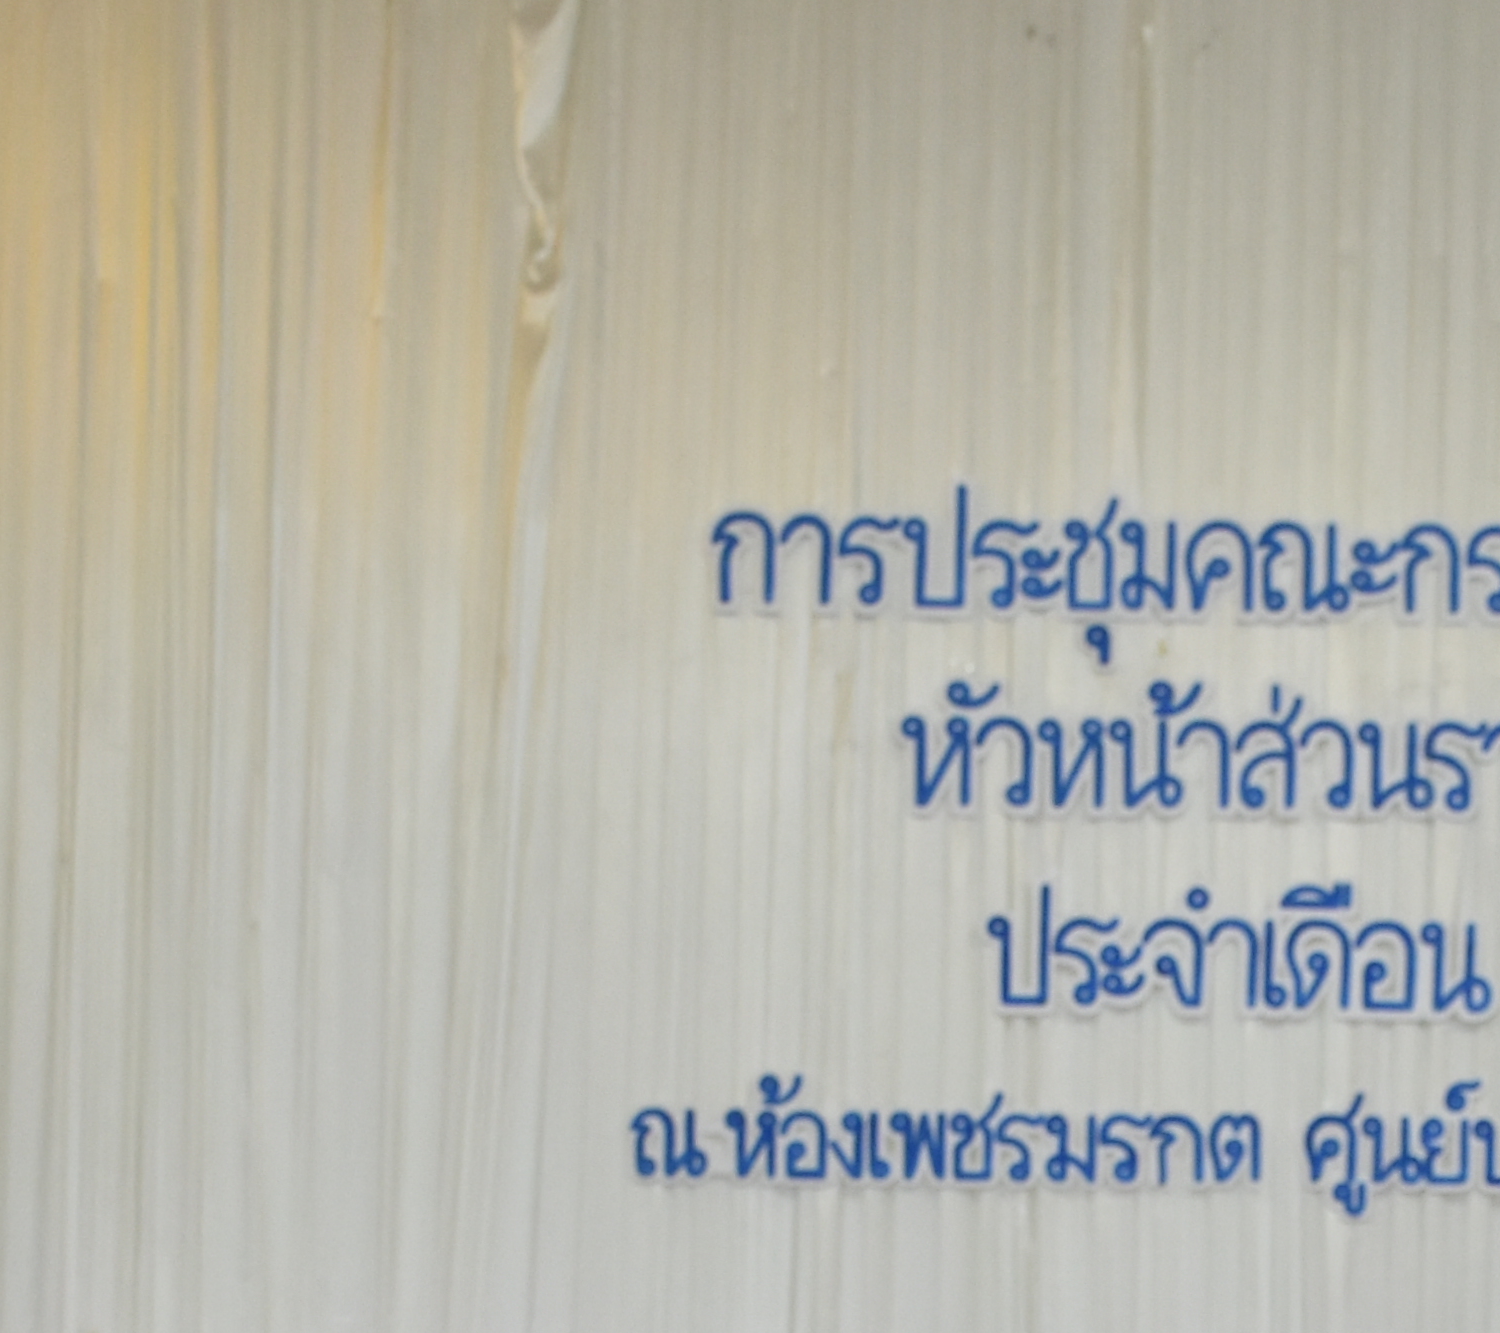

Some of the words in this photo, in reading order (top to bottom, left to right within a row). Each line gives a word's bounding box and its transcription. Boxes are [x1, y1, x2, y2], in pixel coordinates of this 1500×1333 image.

[988, 883, 1494, 1014] ประจำเดือน
[631, 1106, 709, 1180] ณ
[725, 1075, 1263, 1185] ห้องเพชรมรกต
